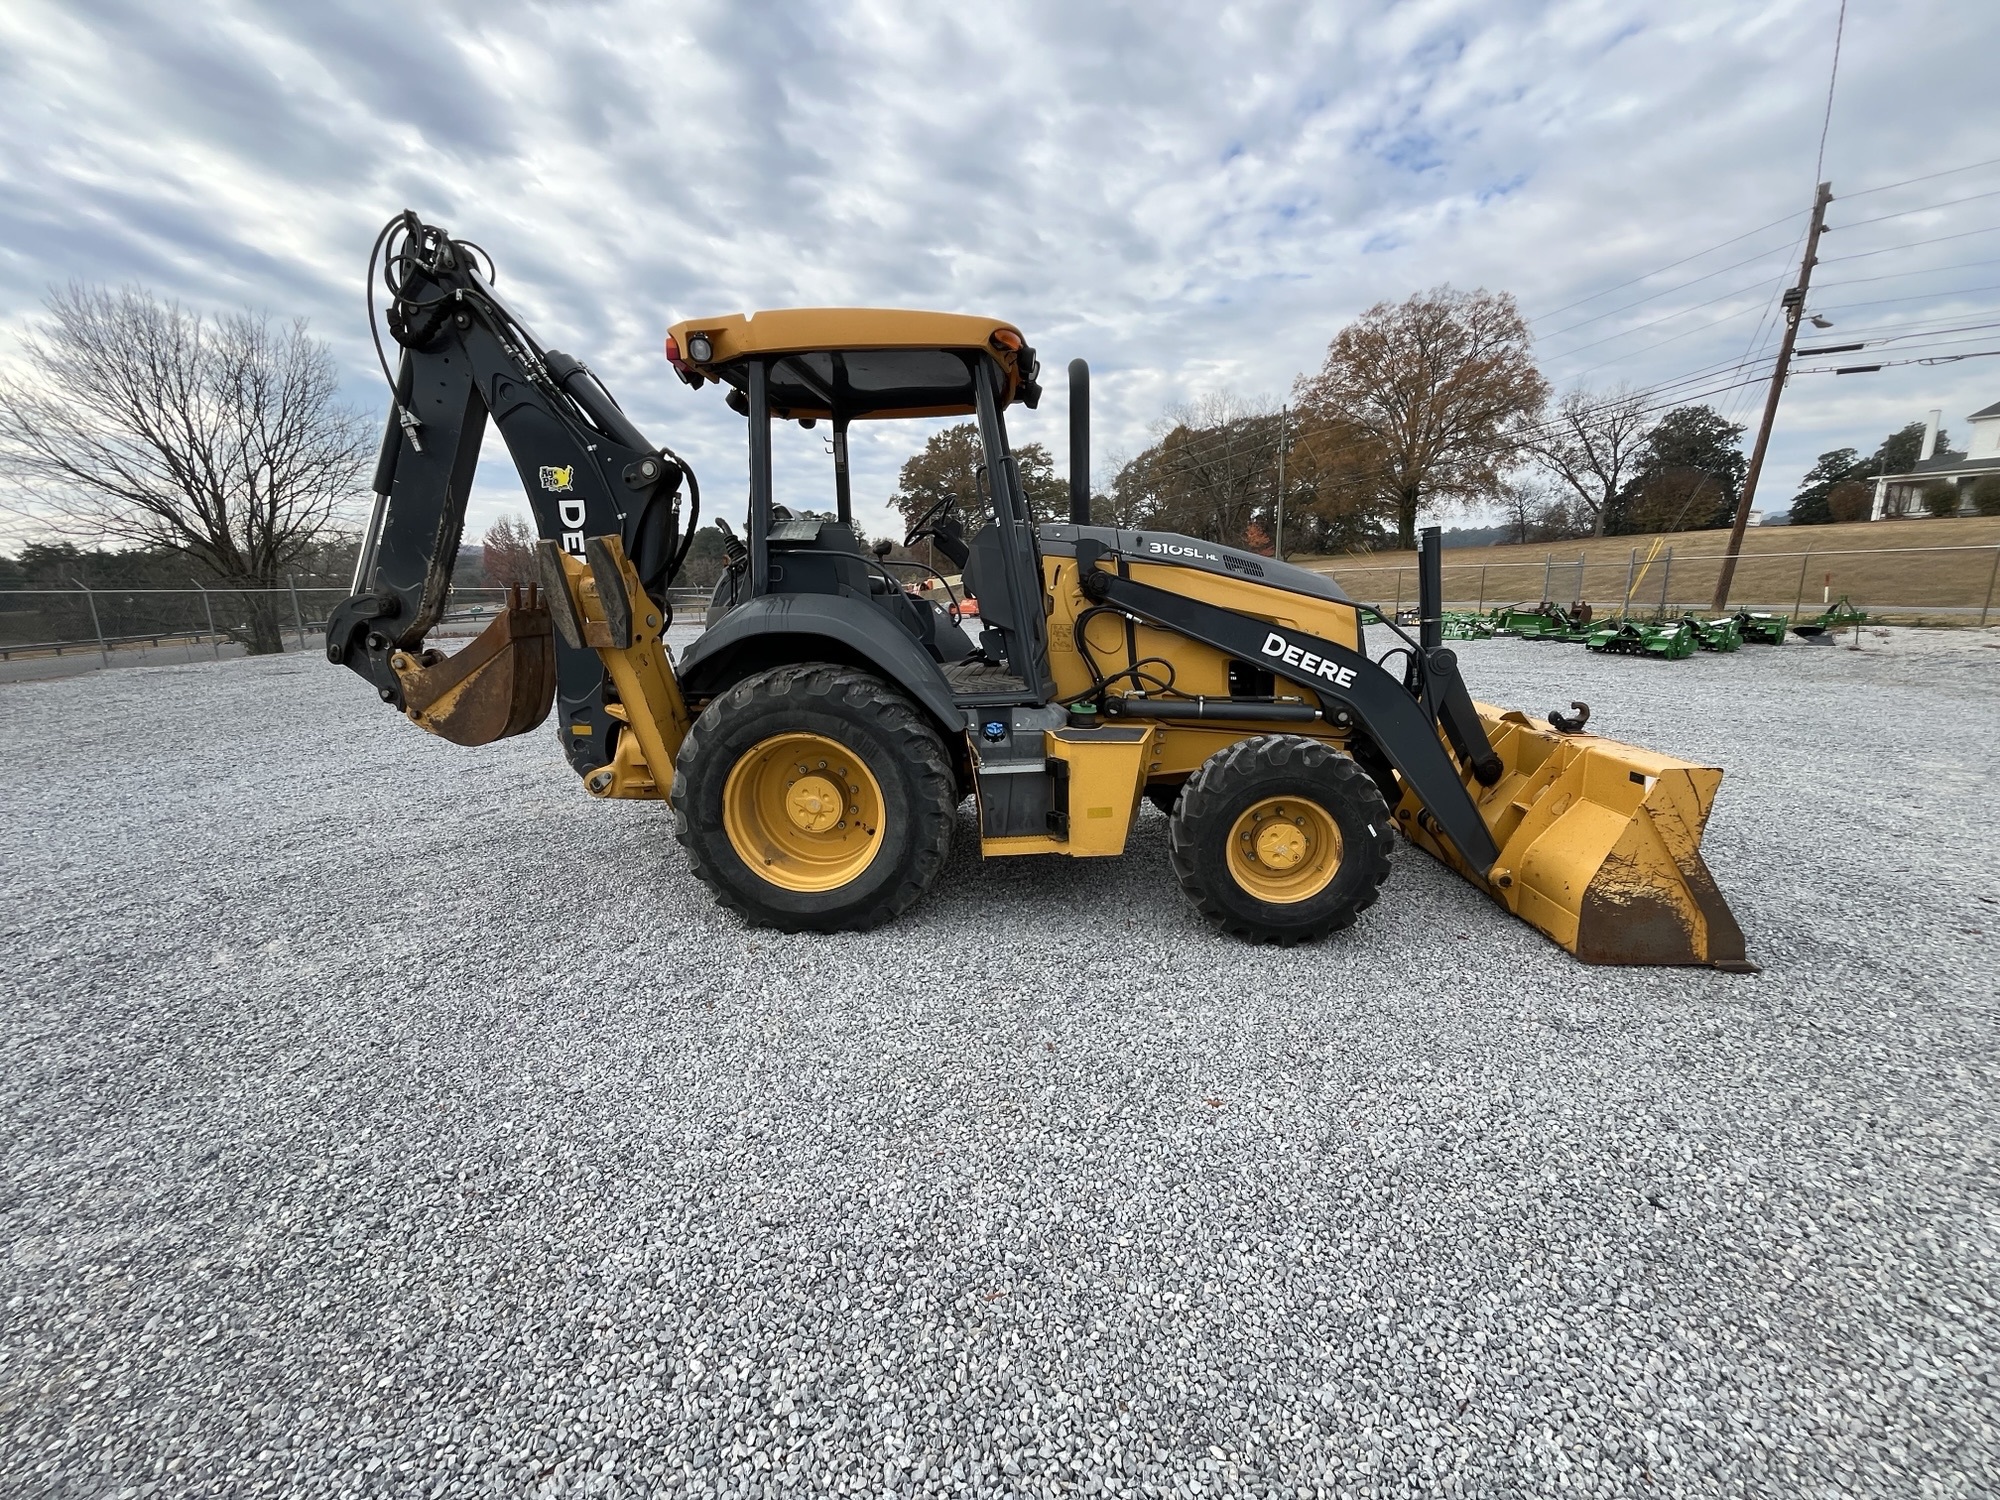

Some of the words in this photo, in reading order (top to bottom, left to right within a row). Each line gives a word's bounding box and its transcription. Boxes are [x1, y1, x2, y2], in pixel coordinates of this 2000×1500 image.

[558, 500, 587, 565] DE
[1149, 542, 1203, 559] 310SL
[1205, 553, 1219, 561] HL
[1261, 632, 1357, 689] DEERE
